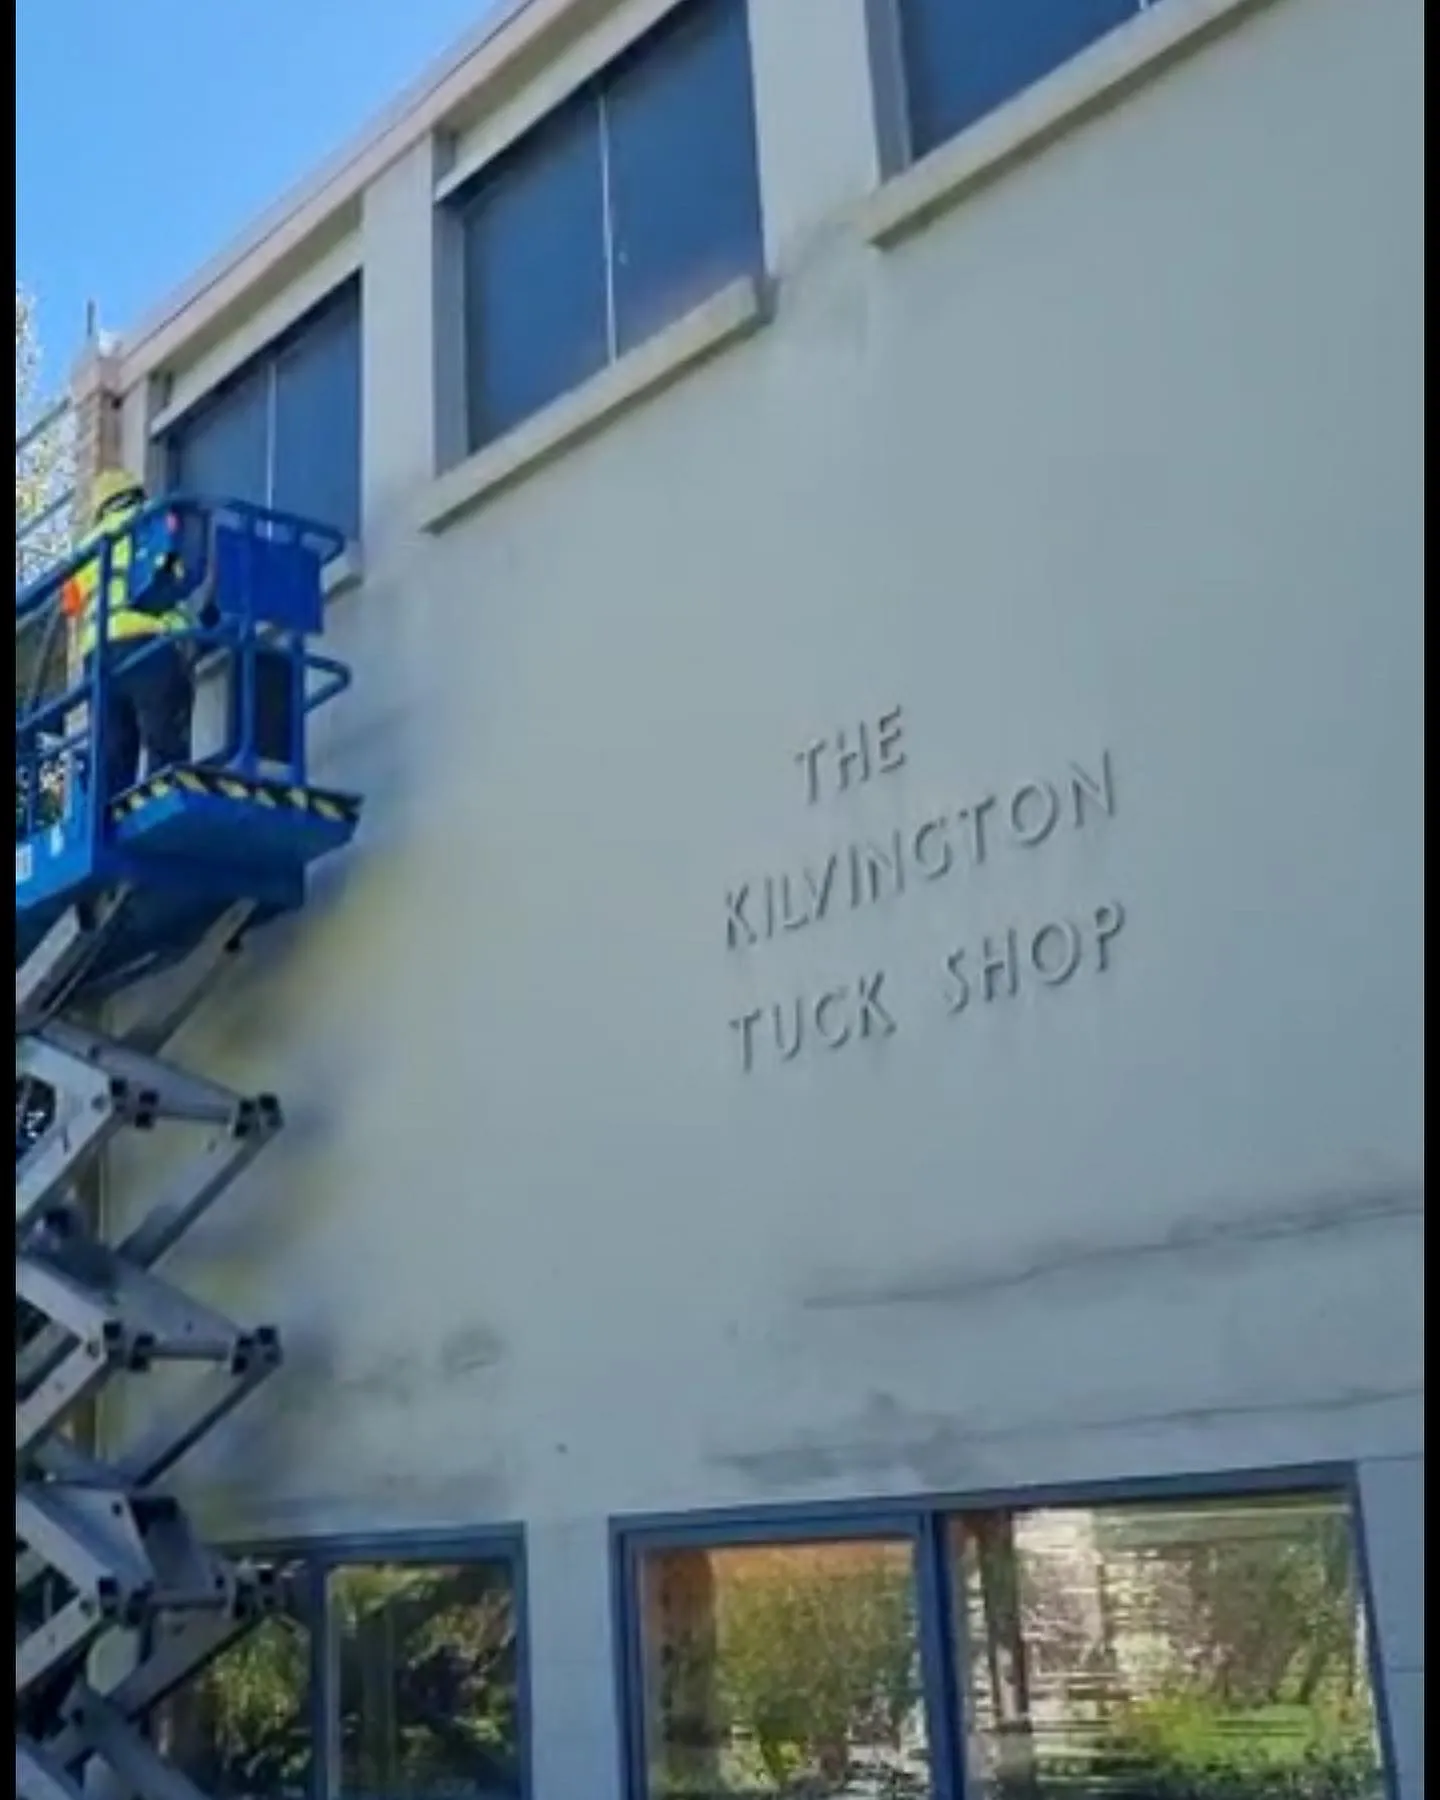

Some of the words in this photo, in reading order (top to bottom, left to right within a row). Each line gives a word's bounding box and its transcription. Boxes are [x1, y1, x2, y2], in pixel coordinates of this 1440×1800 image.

[795, 704, 907, 805] THE
[725, 748, 1117, 950] KILVINGTON
[729, 970, 897, 1073] TUCK
[944, 902, 1126, 1016] SHOP
